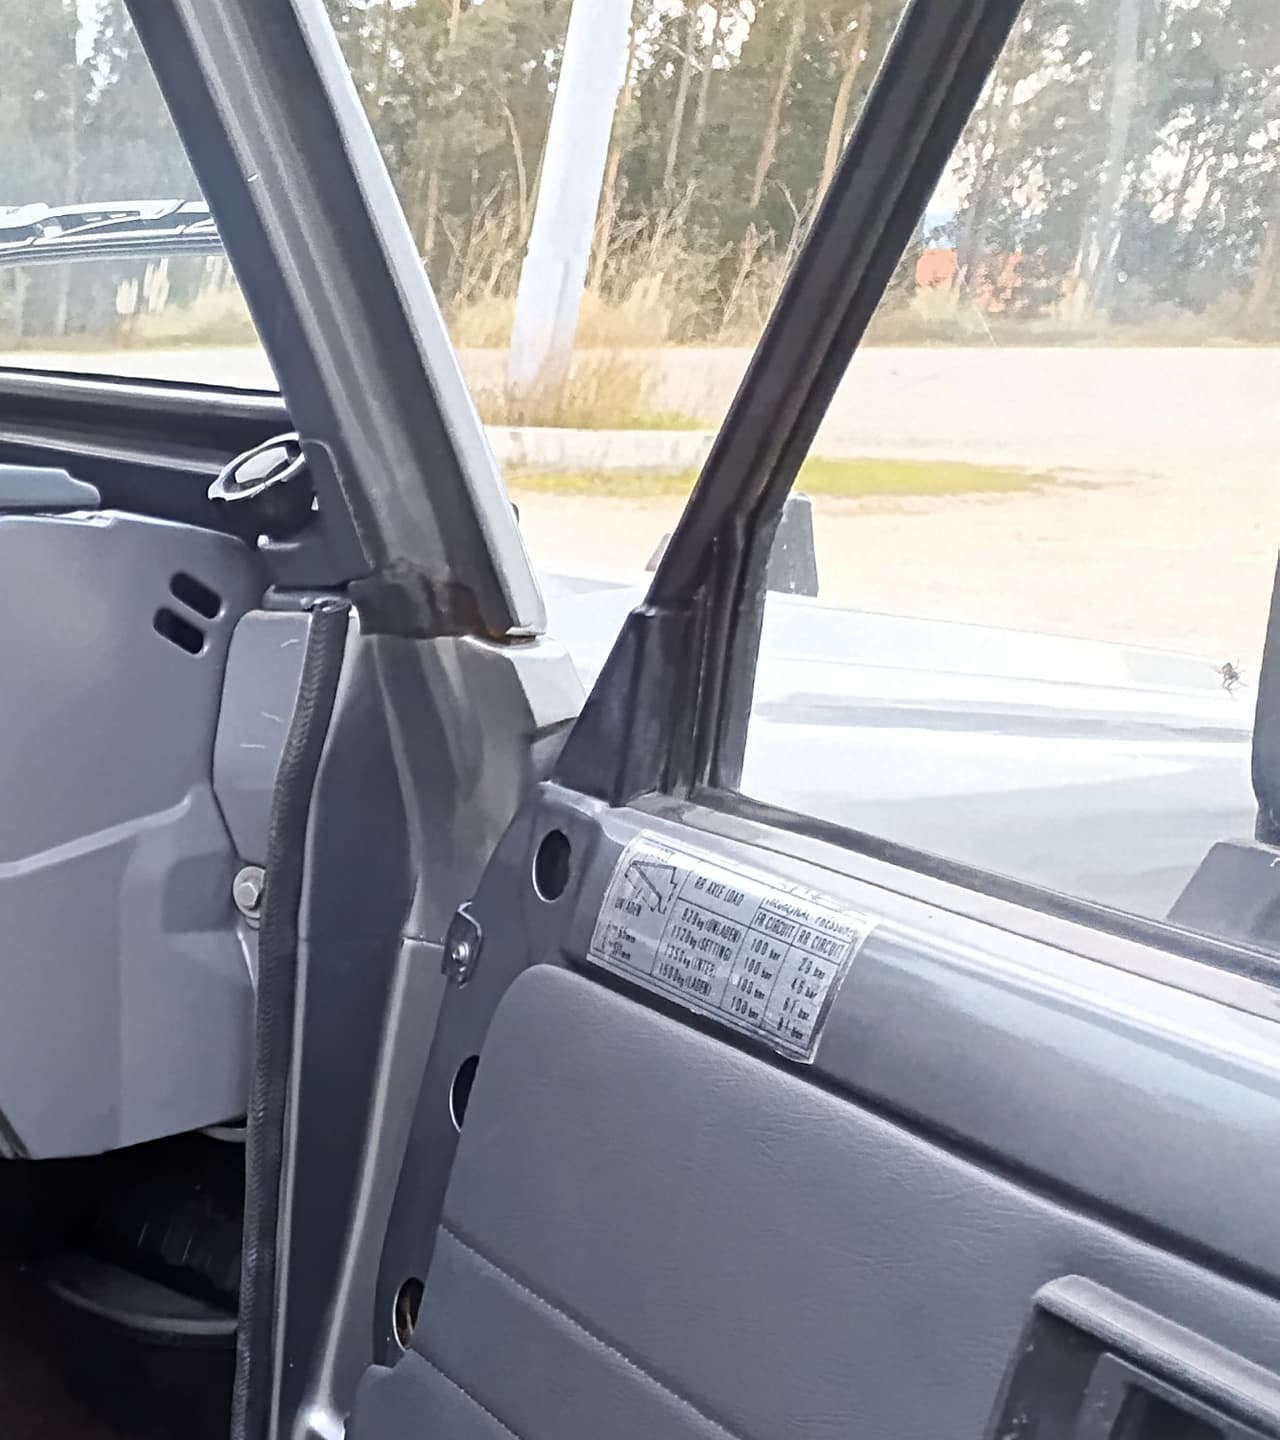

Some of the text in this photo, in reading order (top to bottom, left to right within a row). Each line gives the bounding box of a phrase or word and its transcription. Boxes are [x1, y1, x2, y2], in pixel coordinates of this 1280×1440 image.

[723, 888, 745, 907] LOAD
[765, 915, 795, 939] CIRCUIT
[750, 937, 781, 961] 100 bar
[810, 934, 845, 959] CIRCUIT
[743, 956, 773, 981] 100 bar
[736, 976, 754, 995] 100
[805, 986, 818, 1000] bar
[730, 995, 748, 1015] 100
